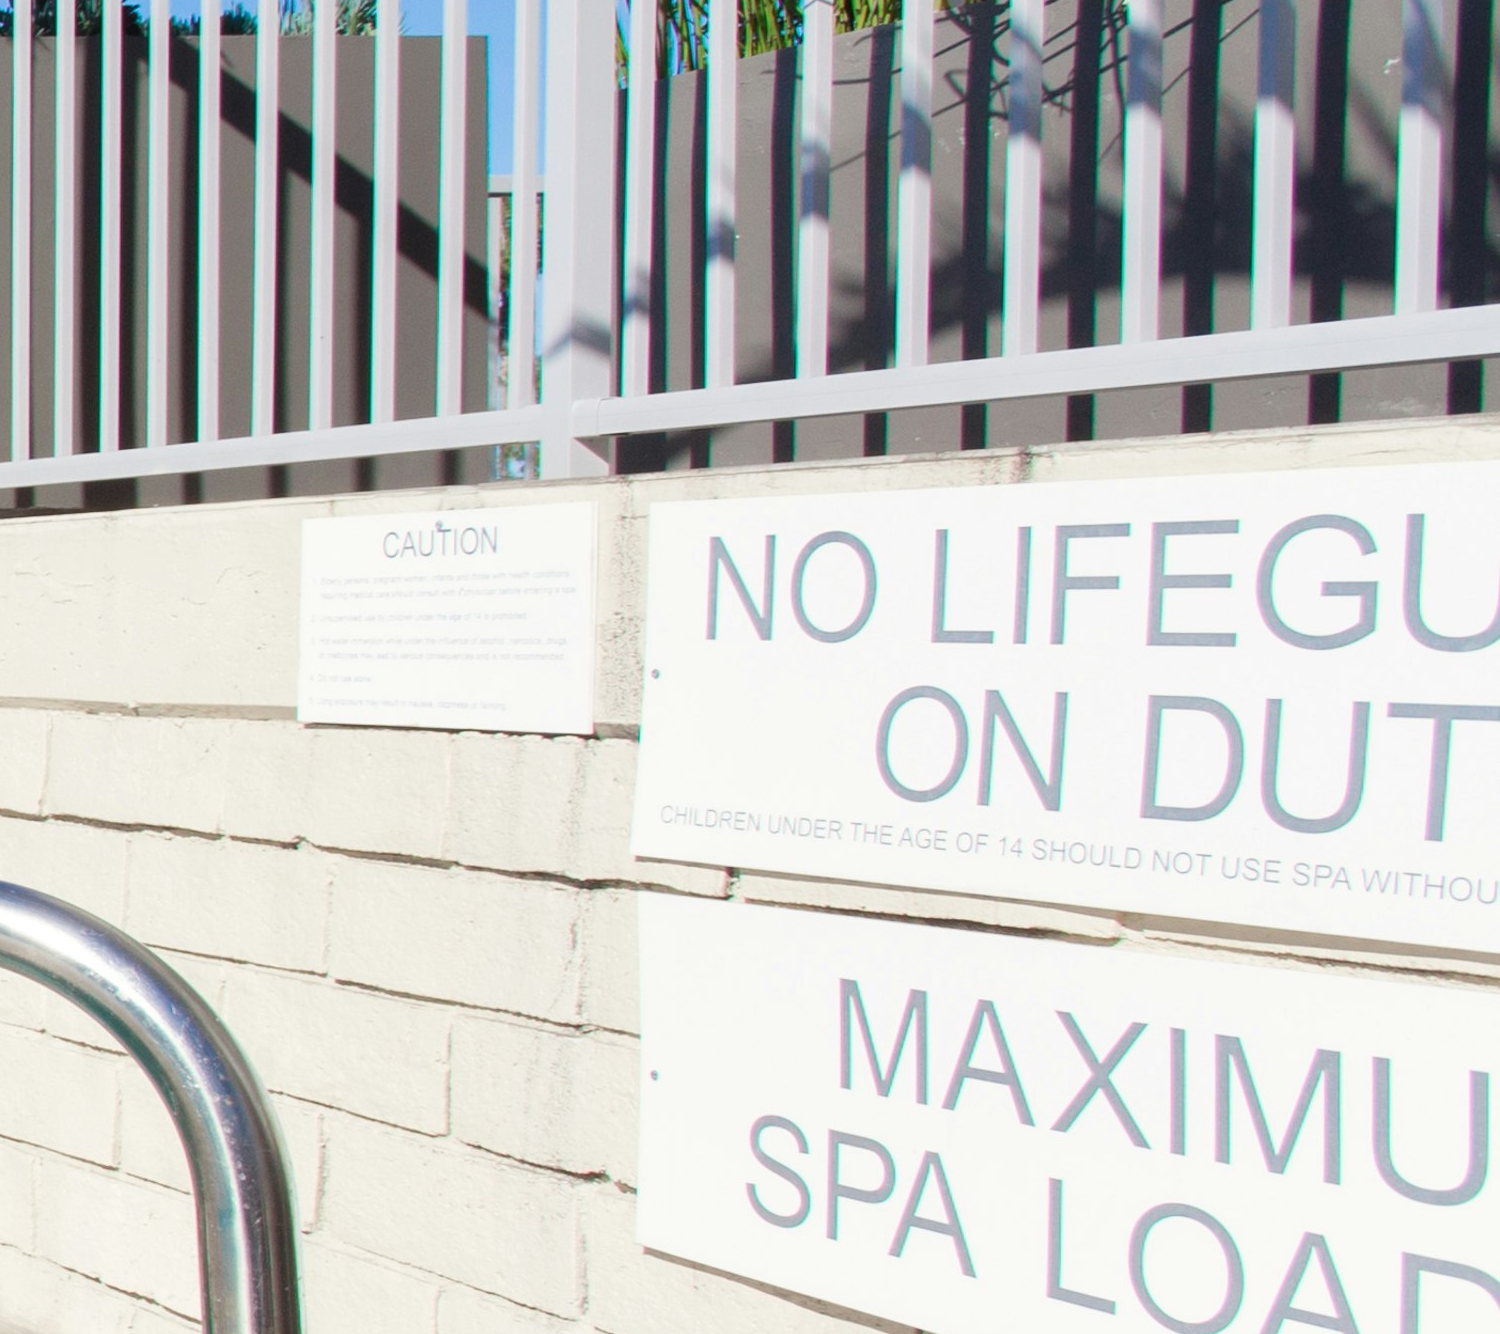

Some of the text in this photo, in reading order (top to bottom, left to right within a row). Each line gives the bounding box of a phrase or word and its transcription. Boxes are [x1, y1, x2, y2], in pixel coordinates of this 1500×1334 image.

[382, 525, 499, 559] CAUTION
[705, 512, 1500, 653] NO LIFEGU
[876, 685, 1500, 843] ON DUT
[660, 804, 1500, 905] CHILDREN UNDER THE AGE OF 14 SHOULD NOT USE SPA WITHOU
[837, 978, 1491, 1207] MAXIMU
[745, 1114, 978, 1280] SPA
